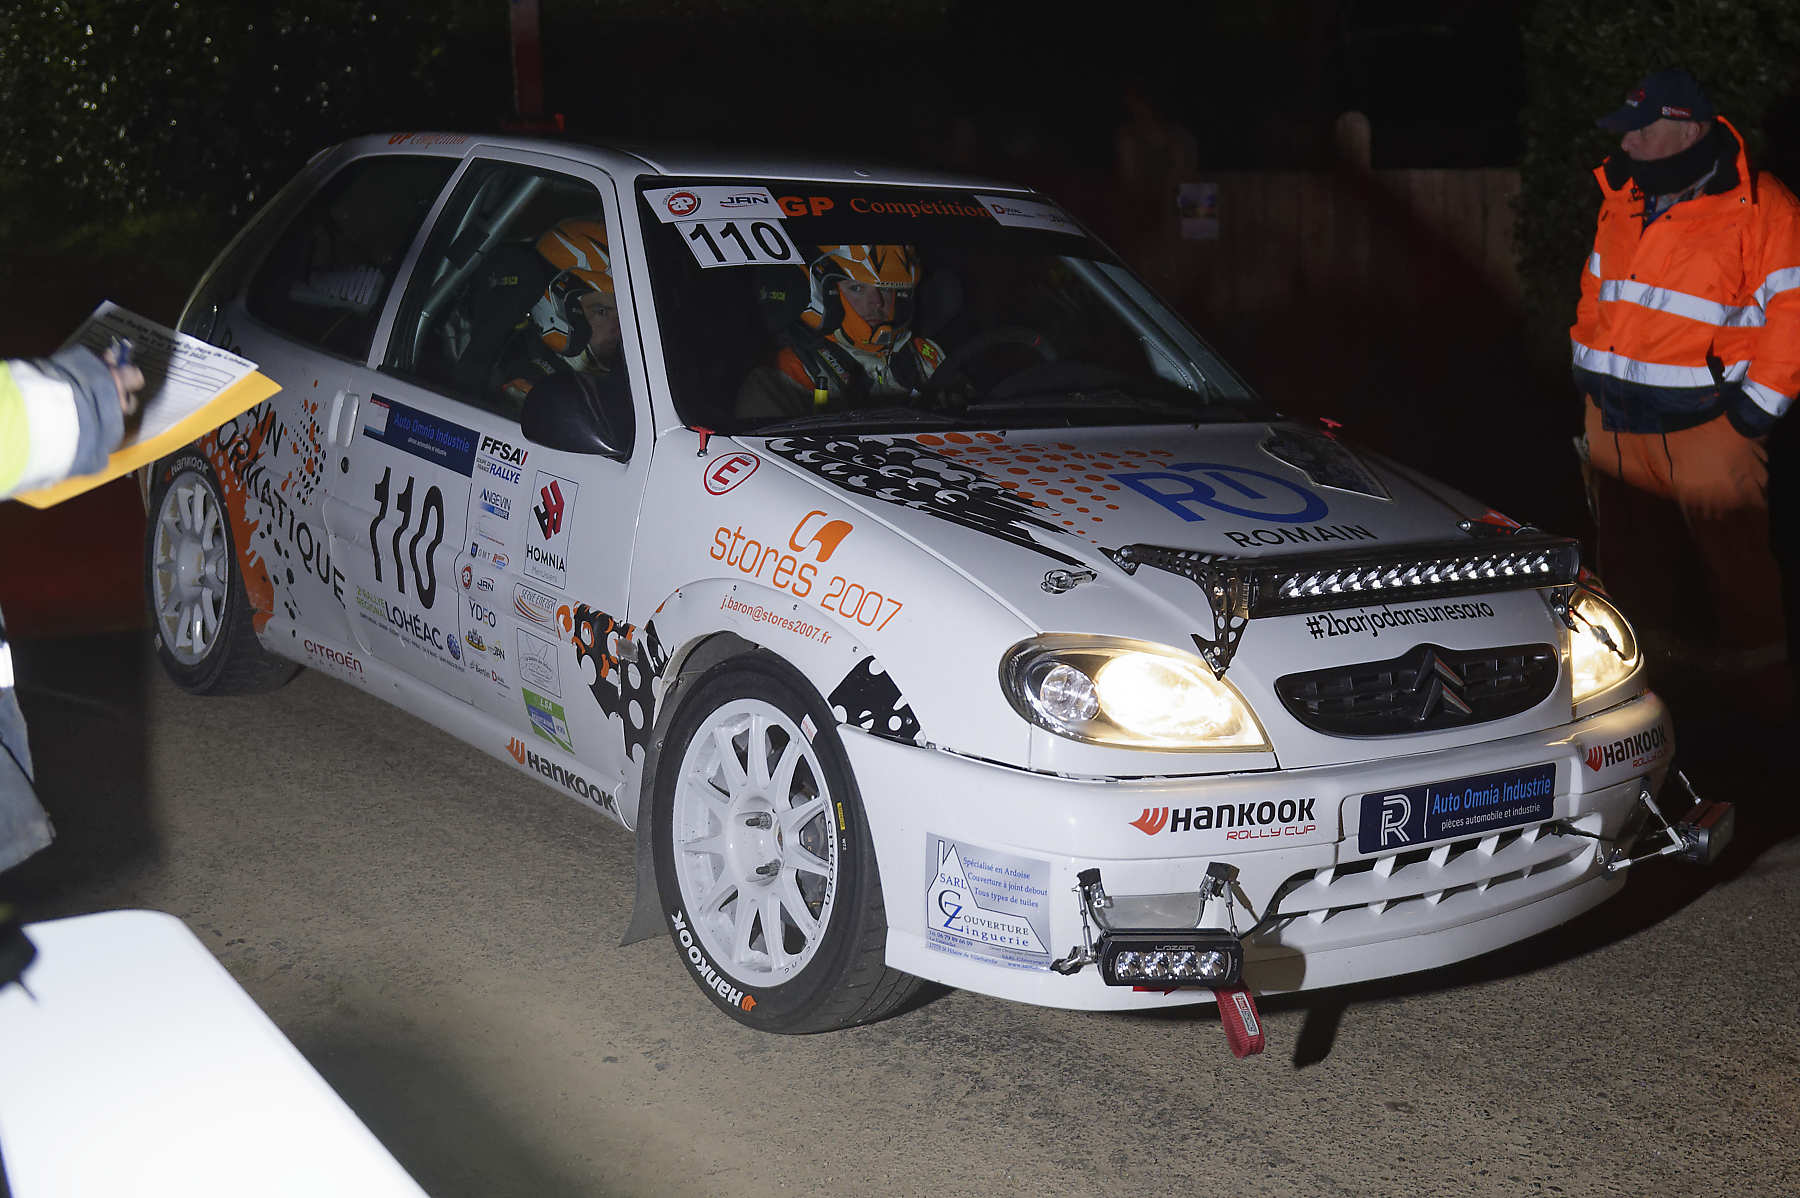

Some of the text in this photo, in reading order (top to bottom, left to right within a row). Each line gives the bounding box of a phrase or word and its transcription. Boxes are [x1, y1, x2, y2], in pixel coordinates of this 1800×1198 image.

[776, 196, 835, 217] GP
[689, 221, 792, 263] 110
[480, 436, 522, 466] FFSA
[489, 463, 520, 485] RALLYE
[712, 456, 751, 486] E
[370, 466, 445, 610] 110
[1224, 523, 1379, 548] ROMAIN
[526, 545, 566, 573] HOMNIA
[709, 526, 904, 632] stores 2007
[384, 600, 443, 651] LOHÉAC
[469, 600, 497, 629] YDEO
[720, 594, 832, 645] j.baron@stores2007.fr
[1305, 602, 1495, 640] #2barjodansunesaxo
[1432, 775, 1551, 816] Auto Omnia Industrie
[1284, 824, 1317, 837] CUP
[1441, 802, 1541, 832] pièces automobile et industrie
[940, 872, 968, 890] SARL
[967, 871, 1001, 887] Couverture
[1024, 887, 1048, 897] debout
[1004, 868, 1031, 880] Ardoise
[975, 887, 990, 898] Tous
[991, 893, 1009, 903] types
